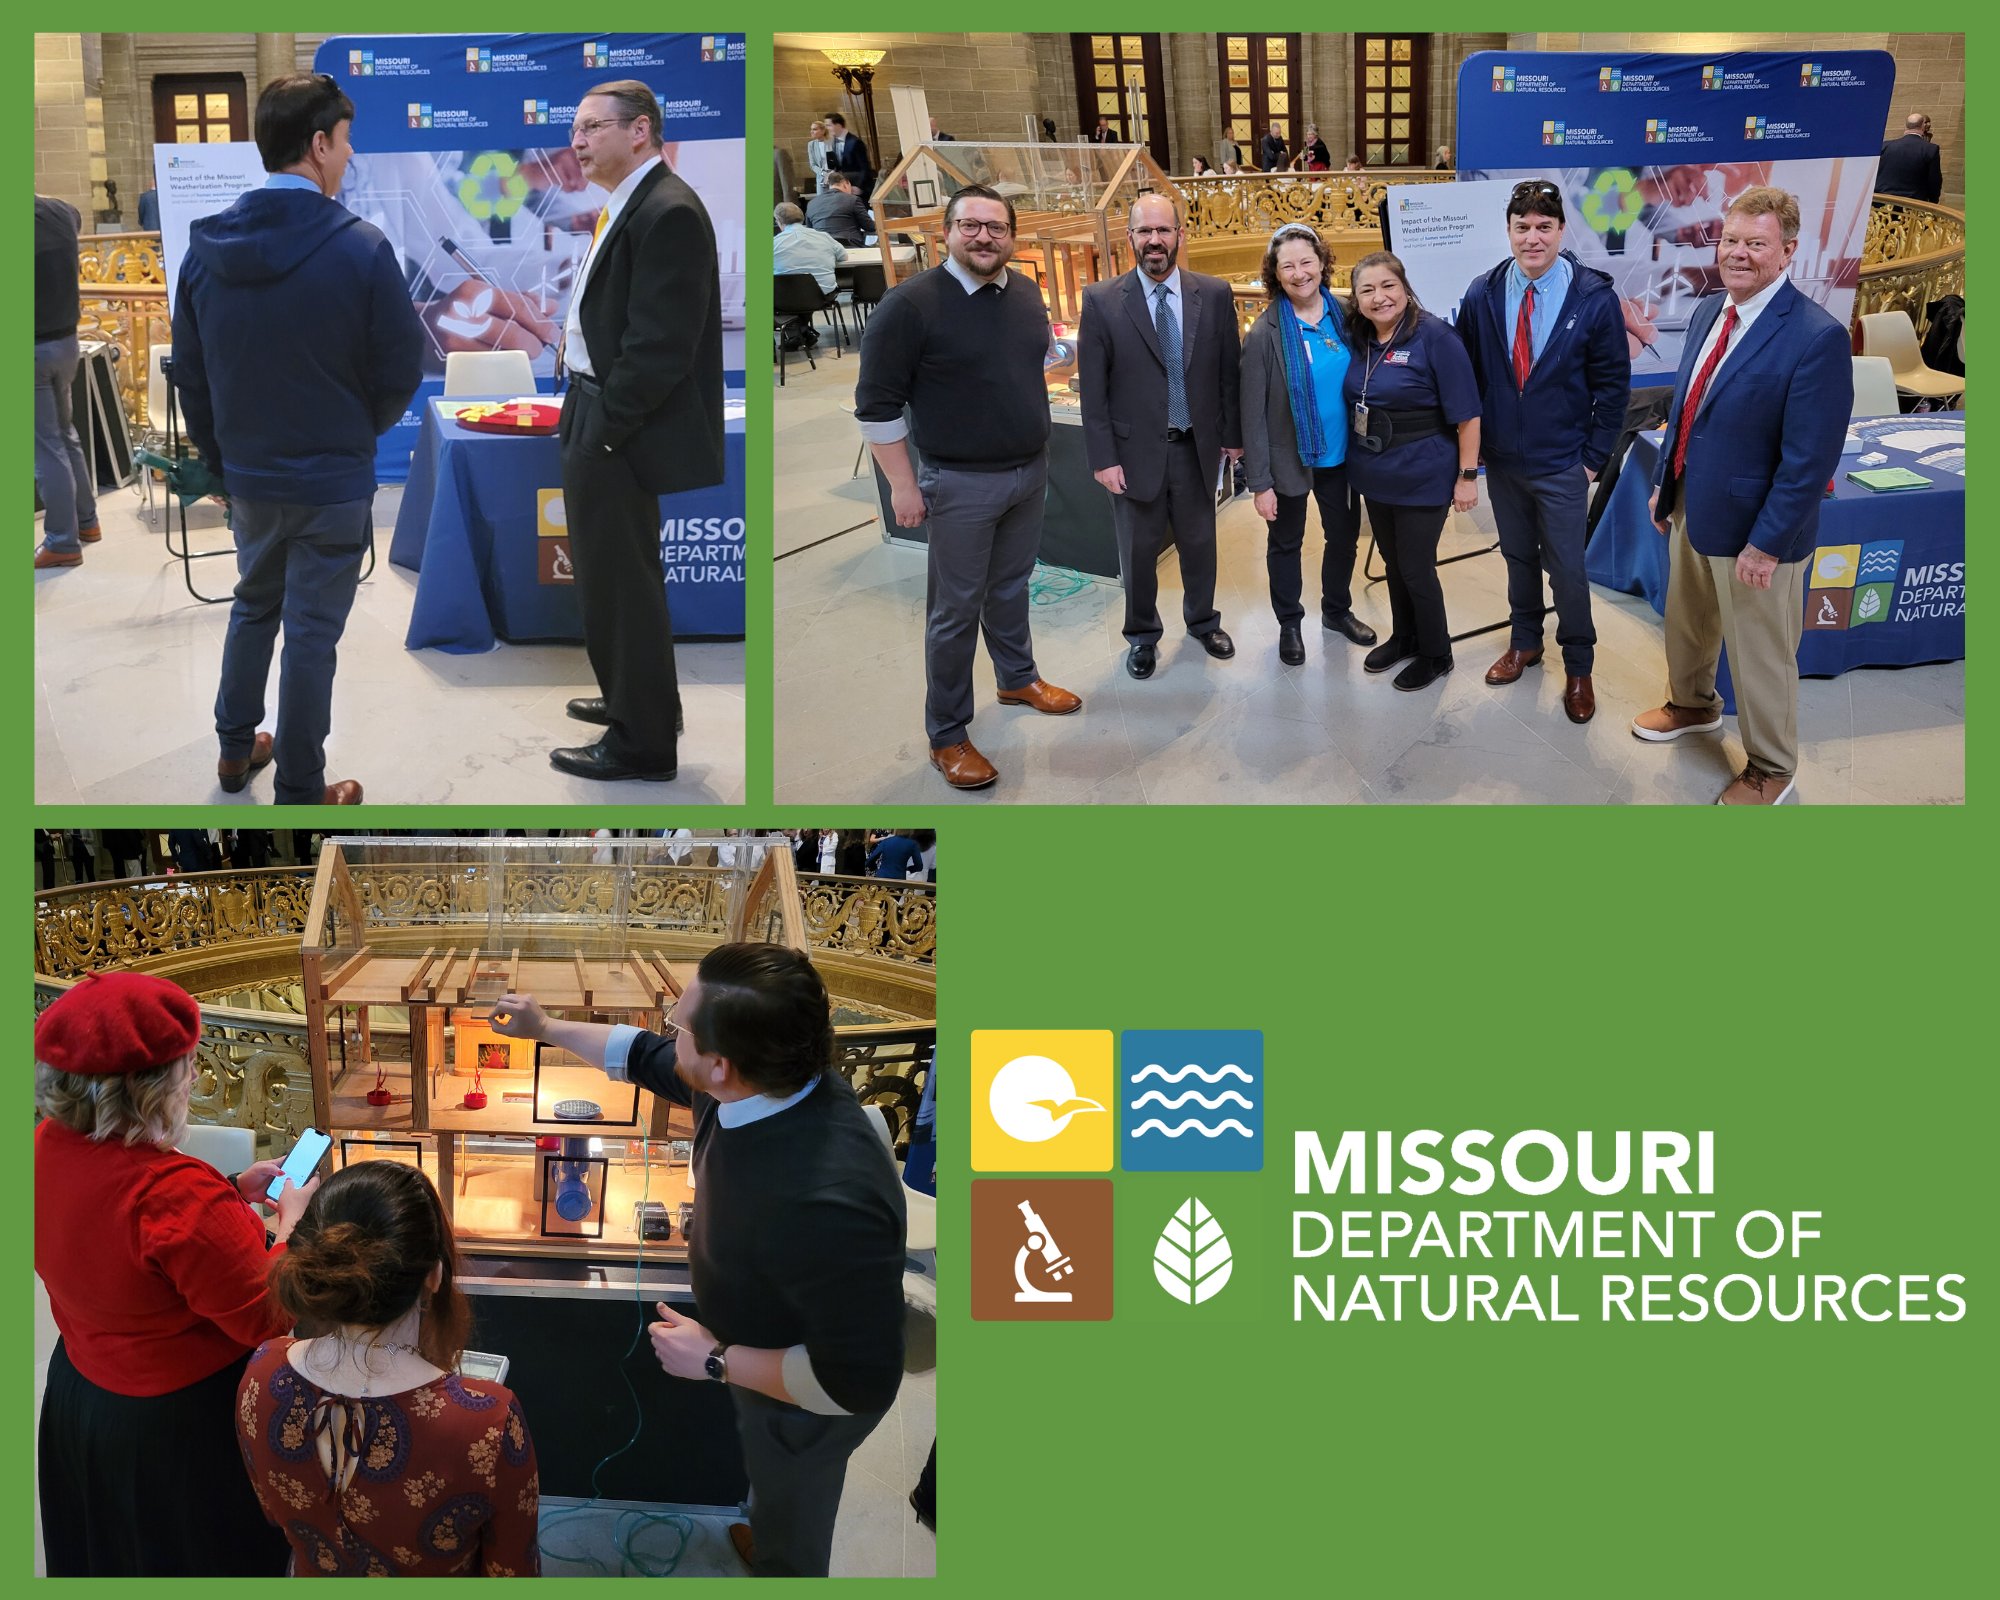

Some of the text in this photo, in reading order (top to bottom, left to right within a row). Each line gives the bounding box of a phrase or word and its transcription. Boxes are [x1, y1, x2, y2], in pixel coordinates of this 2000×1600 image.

[1401, 218, 1422, 226] Impact
[1402, 223, 1474, 234] Weatherization Program
[660, 544, 746, 562] EPARTM
[1904, 562, 1965, 587] MISS
[1898, 585, 1965, 605] DEPART
[1895, 603, 1965, 622] NATURA
